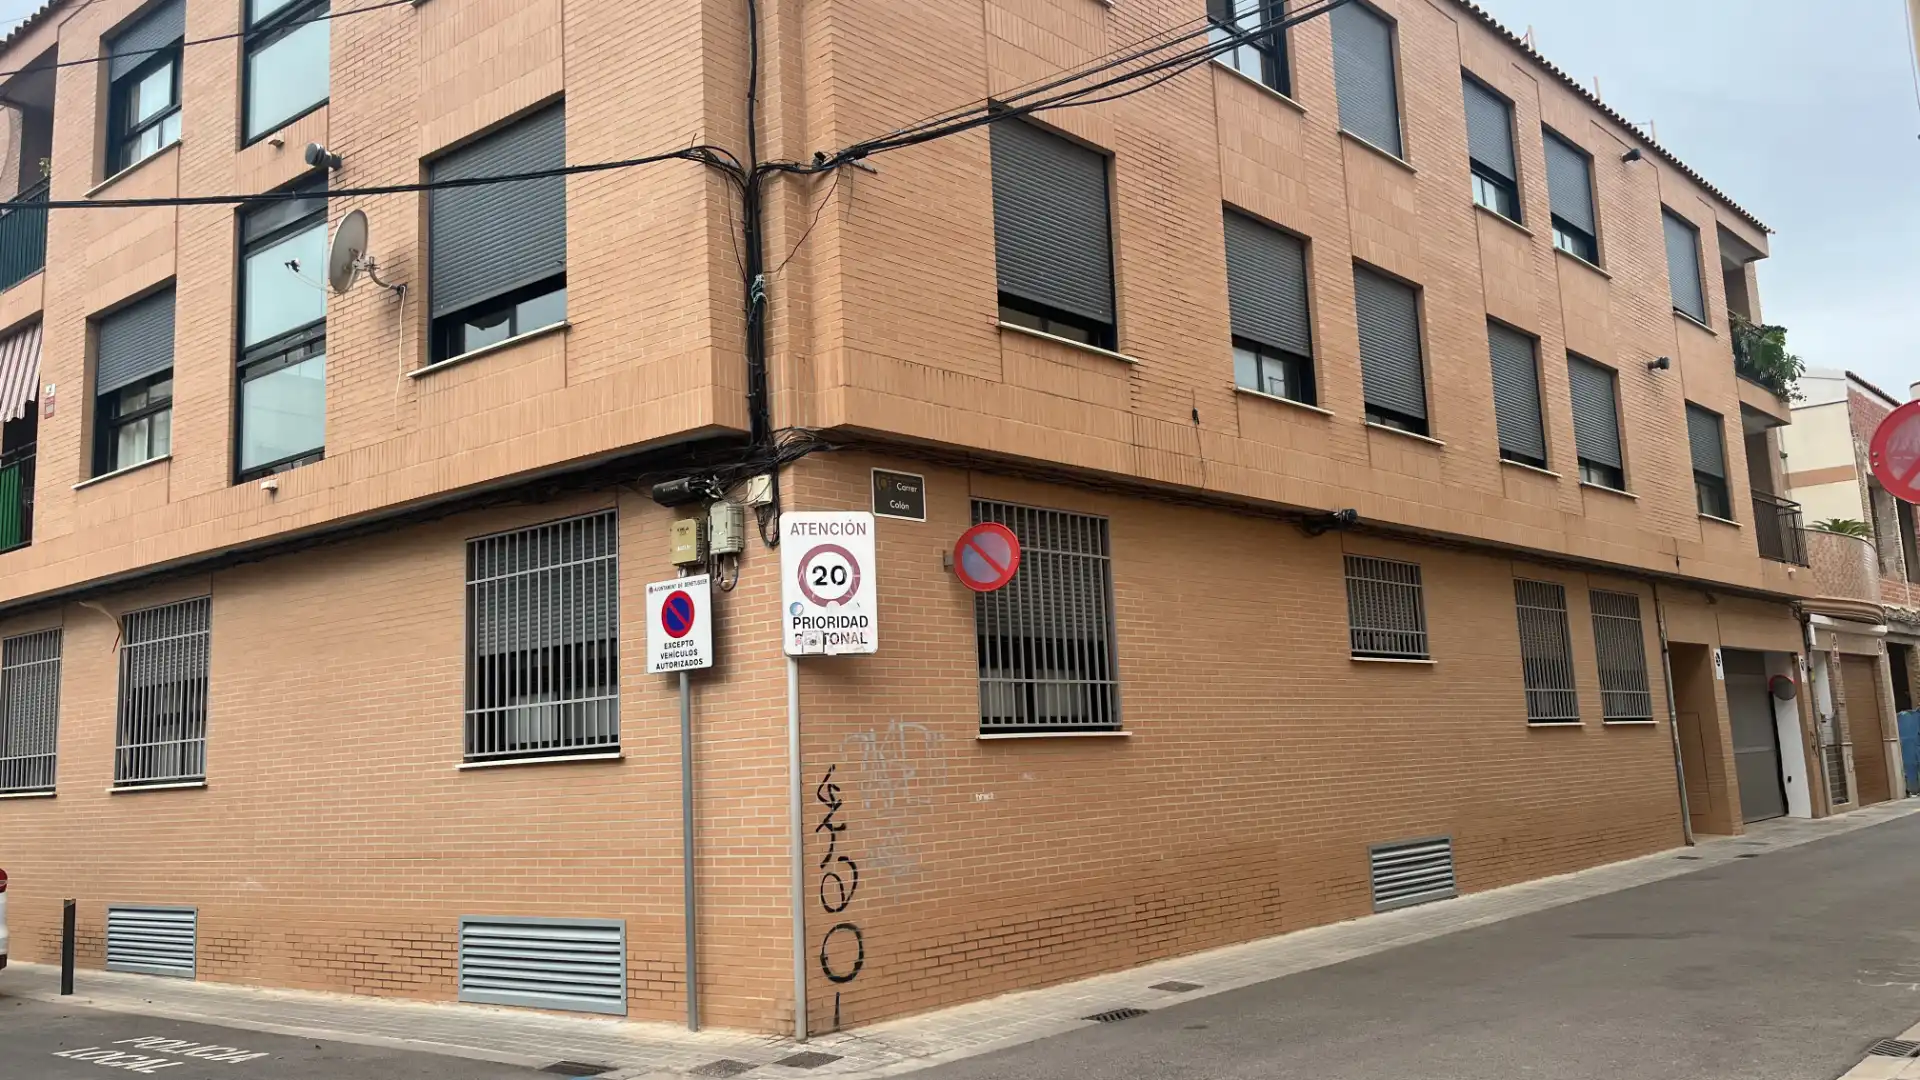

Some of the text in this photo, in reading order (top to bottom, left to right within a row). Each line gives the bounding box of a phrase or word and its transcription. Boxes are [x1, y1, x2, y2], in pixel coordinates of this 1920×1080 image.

[897, 482, 917, 492] Carrer
[890, 500, 909, 510] Colón
[790, 519, 867, 536] ATENCIÓN
[812, 565, 848, 586] 20
[792, 615, 869, 630] PRIORIDAD
[664, 640, 694, 649] EXCEPTO
[794, 631, 869, 646] TONAL
[660, 649, 698, 660] VEHÍCULOS
[656, 659, 704, 670] AUTORIZADOS
[51, 1046, 185, 1074] LOCAL
